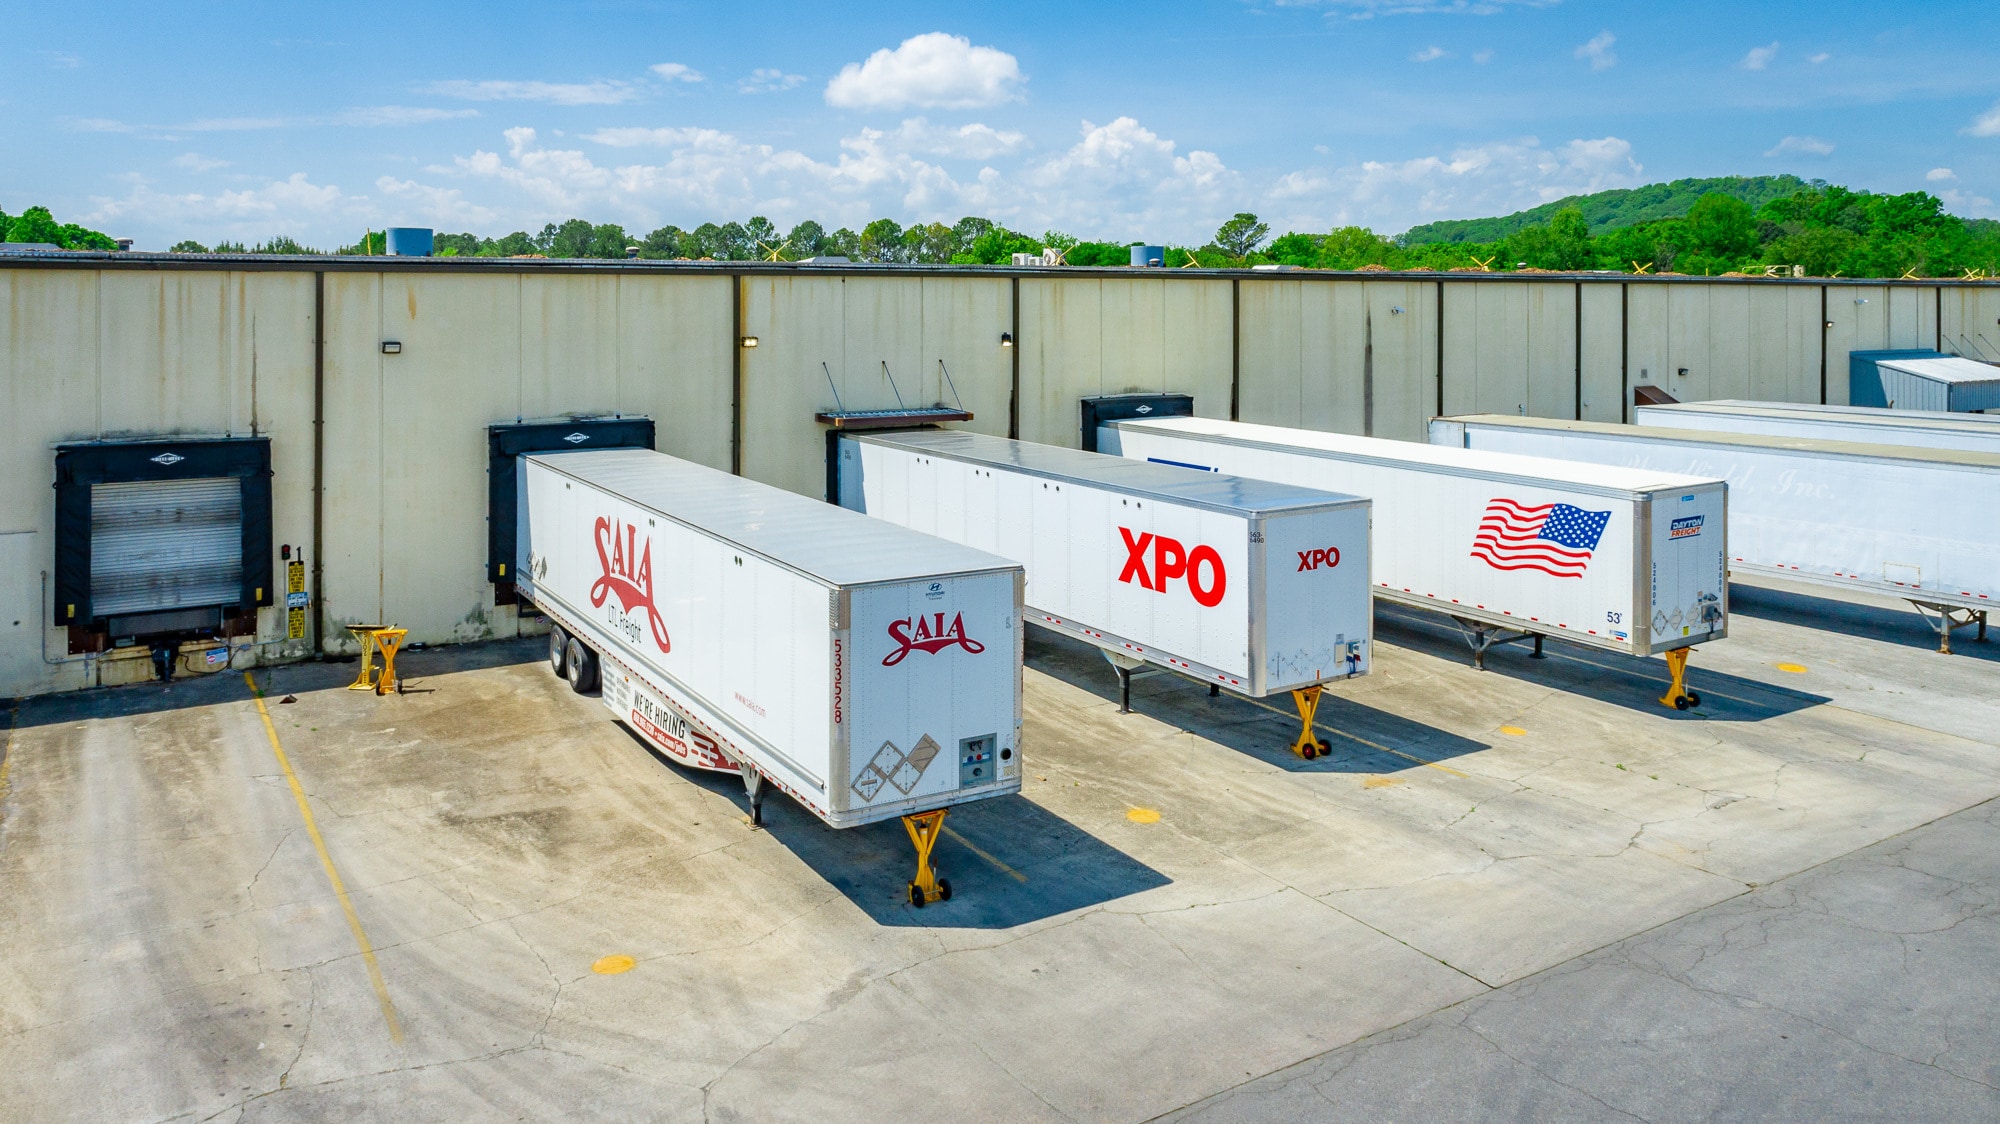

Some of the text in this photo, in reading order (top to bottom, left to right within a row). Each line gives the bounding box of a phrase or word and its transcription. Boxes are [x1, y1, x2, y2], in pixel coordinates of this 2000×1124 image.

[1771, 468, 1835, 499] Inc.
[1671, 526, 1701, 538] FREIGHT
[1672, 517, 1702, 529] DAYTON
[1117, 526, 1227, 608] XPO
[1296, 546, 1341, 572] XPO
[590, 515, 671, 654] SAIA
[608, 603, 642, 643] LTL Freight
[881, 610, 985, 667] SAIA
[834, 639, 842, 724] 533528
[634, 689, 653, 720] WE'RE
[655, 706, 686, 739] HIRING
